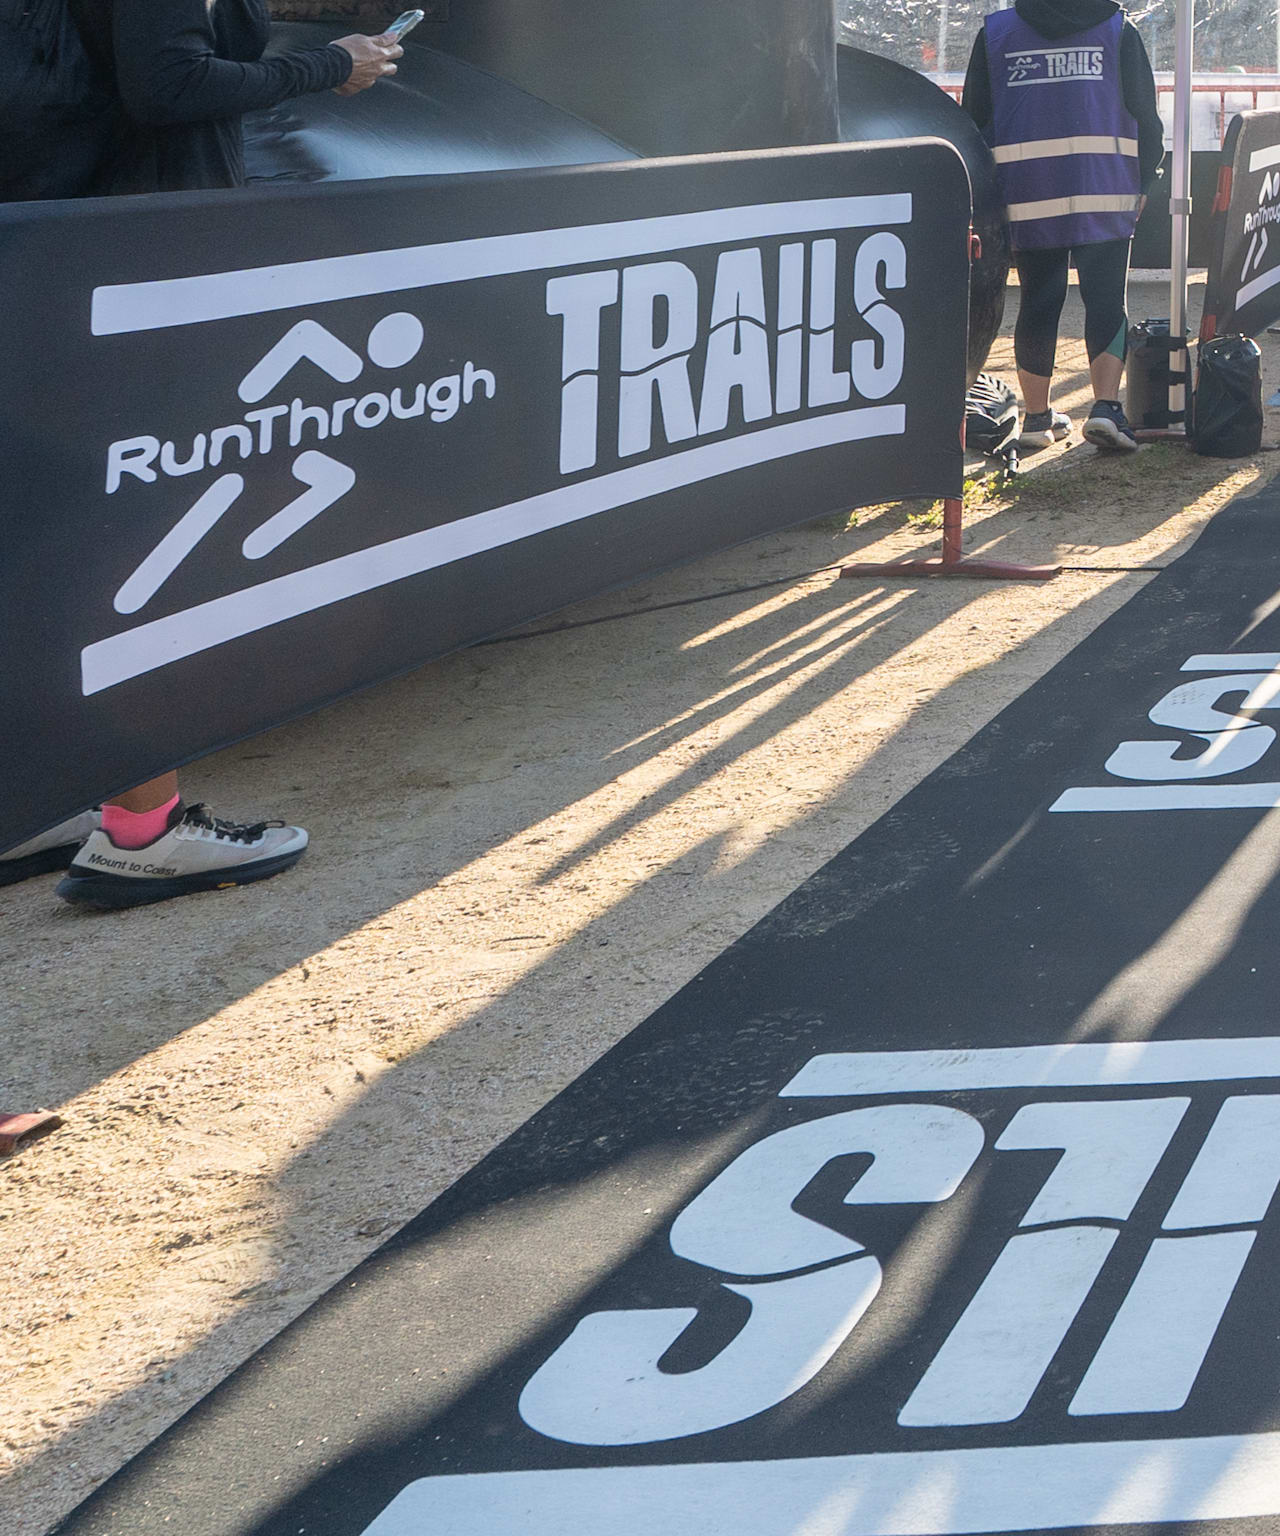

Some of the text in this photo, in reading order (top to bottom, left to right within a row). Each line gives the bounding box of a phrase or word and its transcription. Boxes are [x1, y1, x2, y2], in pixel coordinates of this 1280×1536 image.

[1045, 51, 1103, 77] TRAILS
[105, 231, 907, 494] RunThrough TRAILS
[88, 853, 177, 876] Mount to Coast
